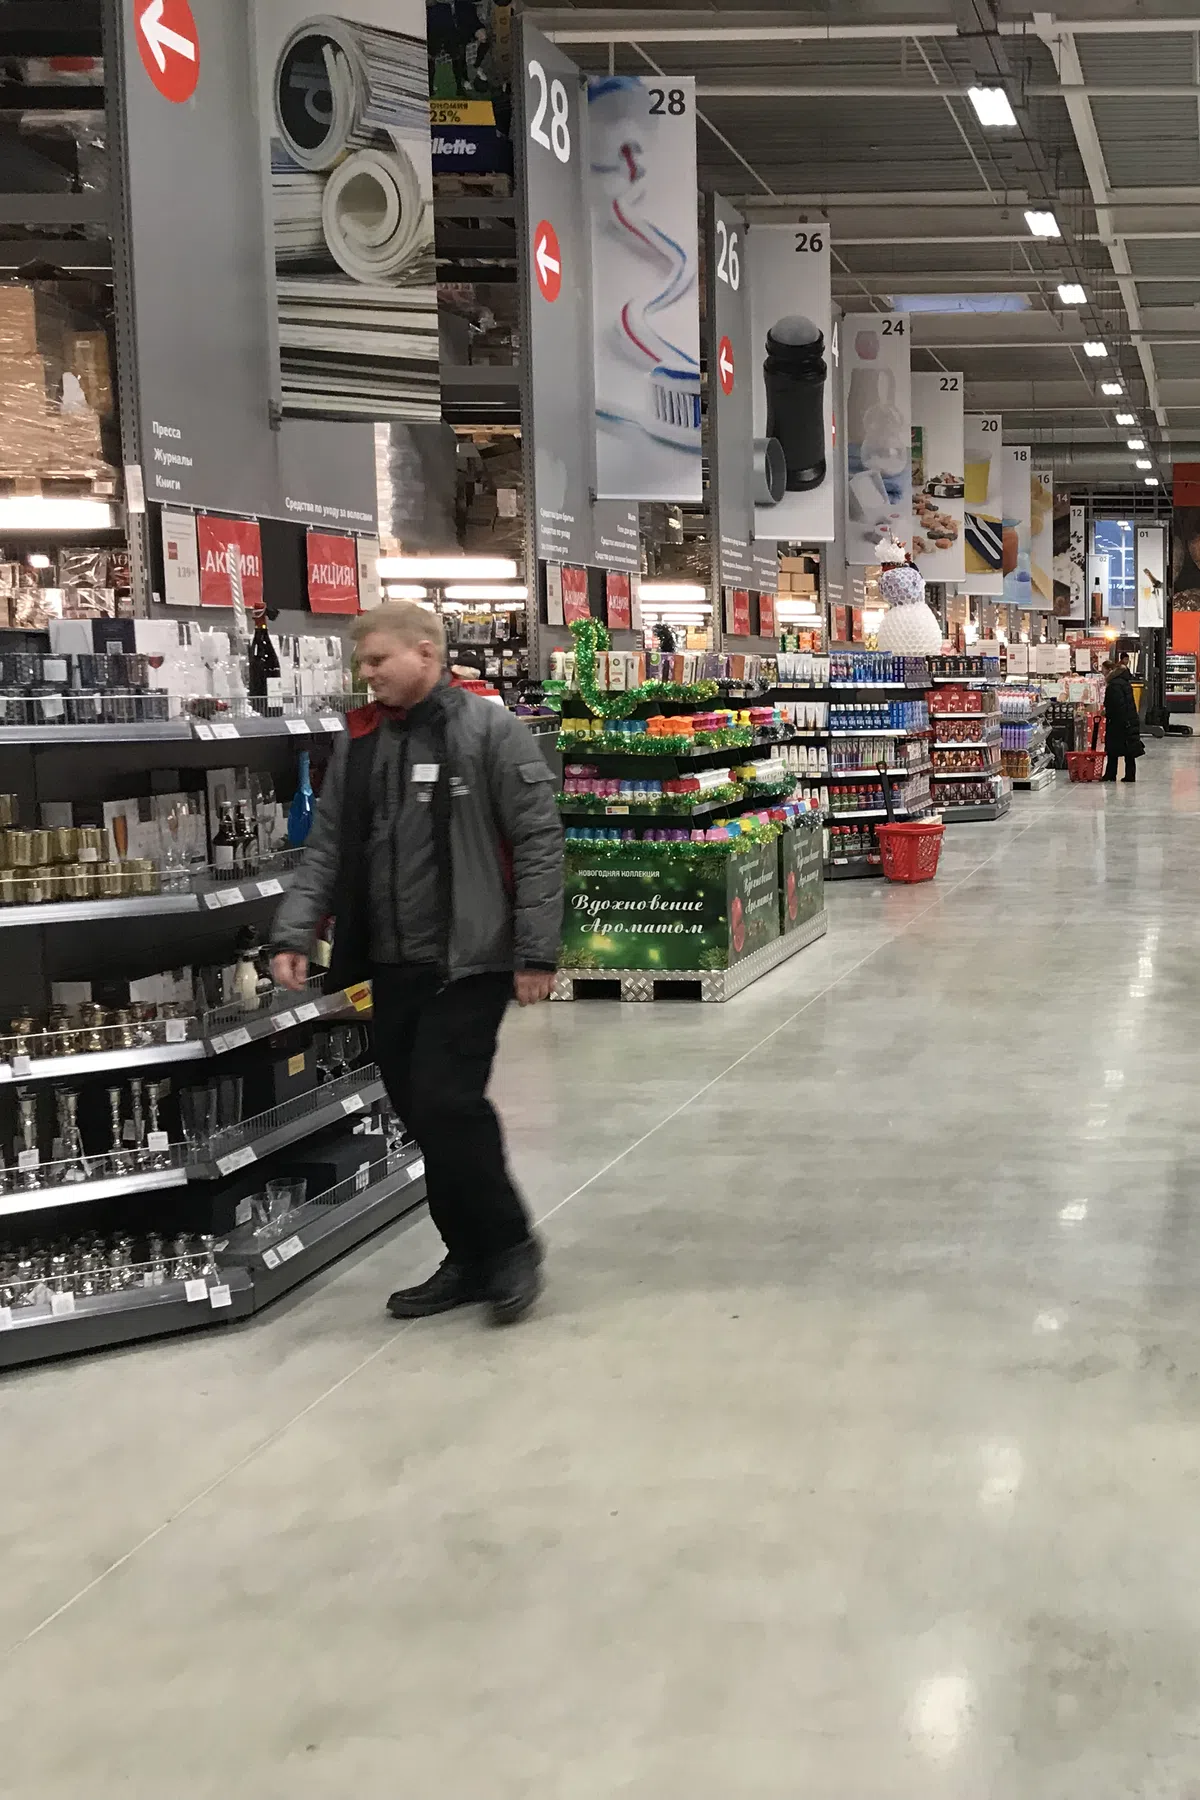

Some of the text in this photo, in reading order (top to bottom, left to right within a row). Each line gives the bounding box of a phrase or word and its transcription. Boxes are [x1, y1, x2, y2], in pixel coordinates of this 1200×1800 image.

[648, 88, 686, 116] 28
[430, 110, 461, 123] 25%
[529, 60, 571, 163] 28
[431, 137, 477, 155] llette
[795, 232, 823, 253] 26
[716, 219, 740, 291] 26
[881, 319, 905, 336] 24
[831, 321, 840, 368] 4
[939, 377, 959, 392] 22
[152, 420, 182, 440] Пресса
[981, 420, 998, 432] 20
[153, 448, 194, 468] Журналы
[1013, 450, 1028, 462] 18
[155, 475, 182, 491] Книги
[1038, 474, 1050, 484] 16
[1056, 493, 1068, 503] 14
[285, 496, 373, 522] Средства по уходу за волосами
[1072, 508, 1083, 517] 12
[1139, 531, 1149, 539] 01
[205, 549, 260, 577] АКИЯ!
[311, 563, 355, 589] АКЦИЯ!
[578, 869, 660, 878] НОВОГОДНЯЯ КОЛЛЕКЦИЯ
[571, 894, 704, 917] Вдохновение
[580, 918, 704, 936] Ароматом
